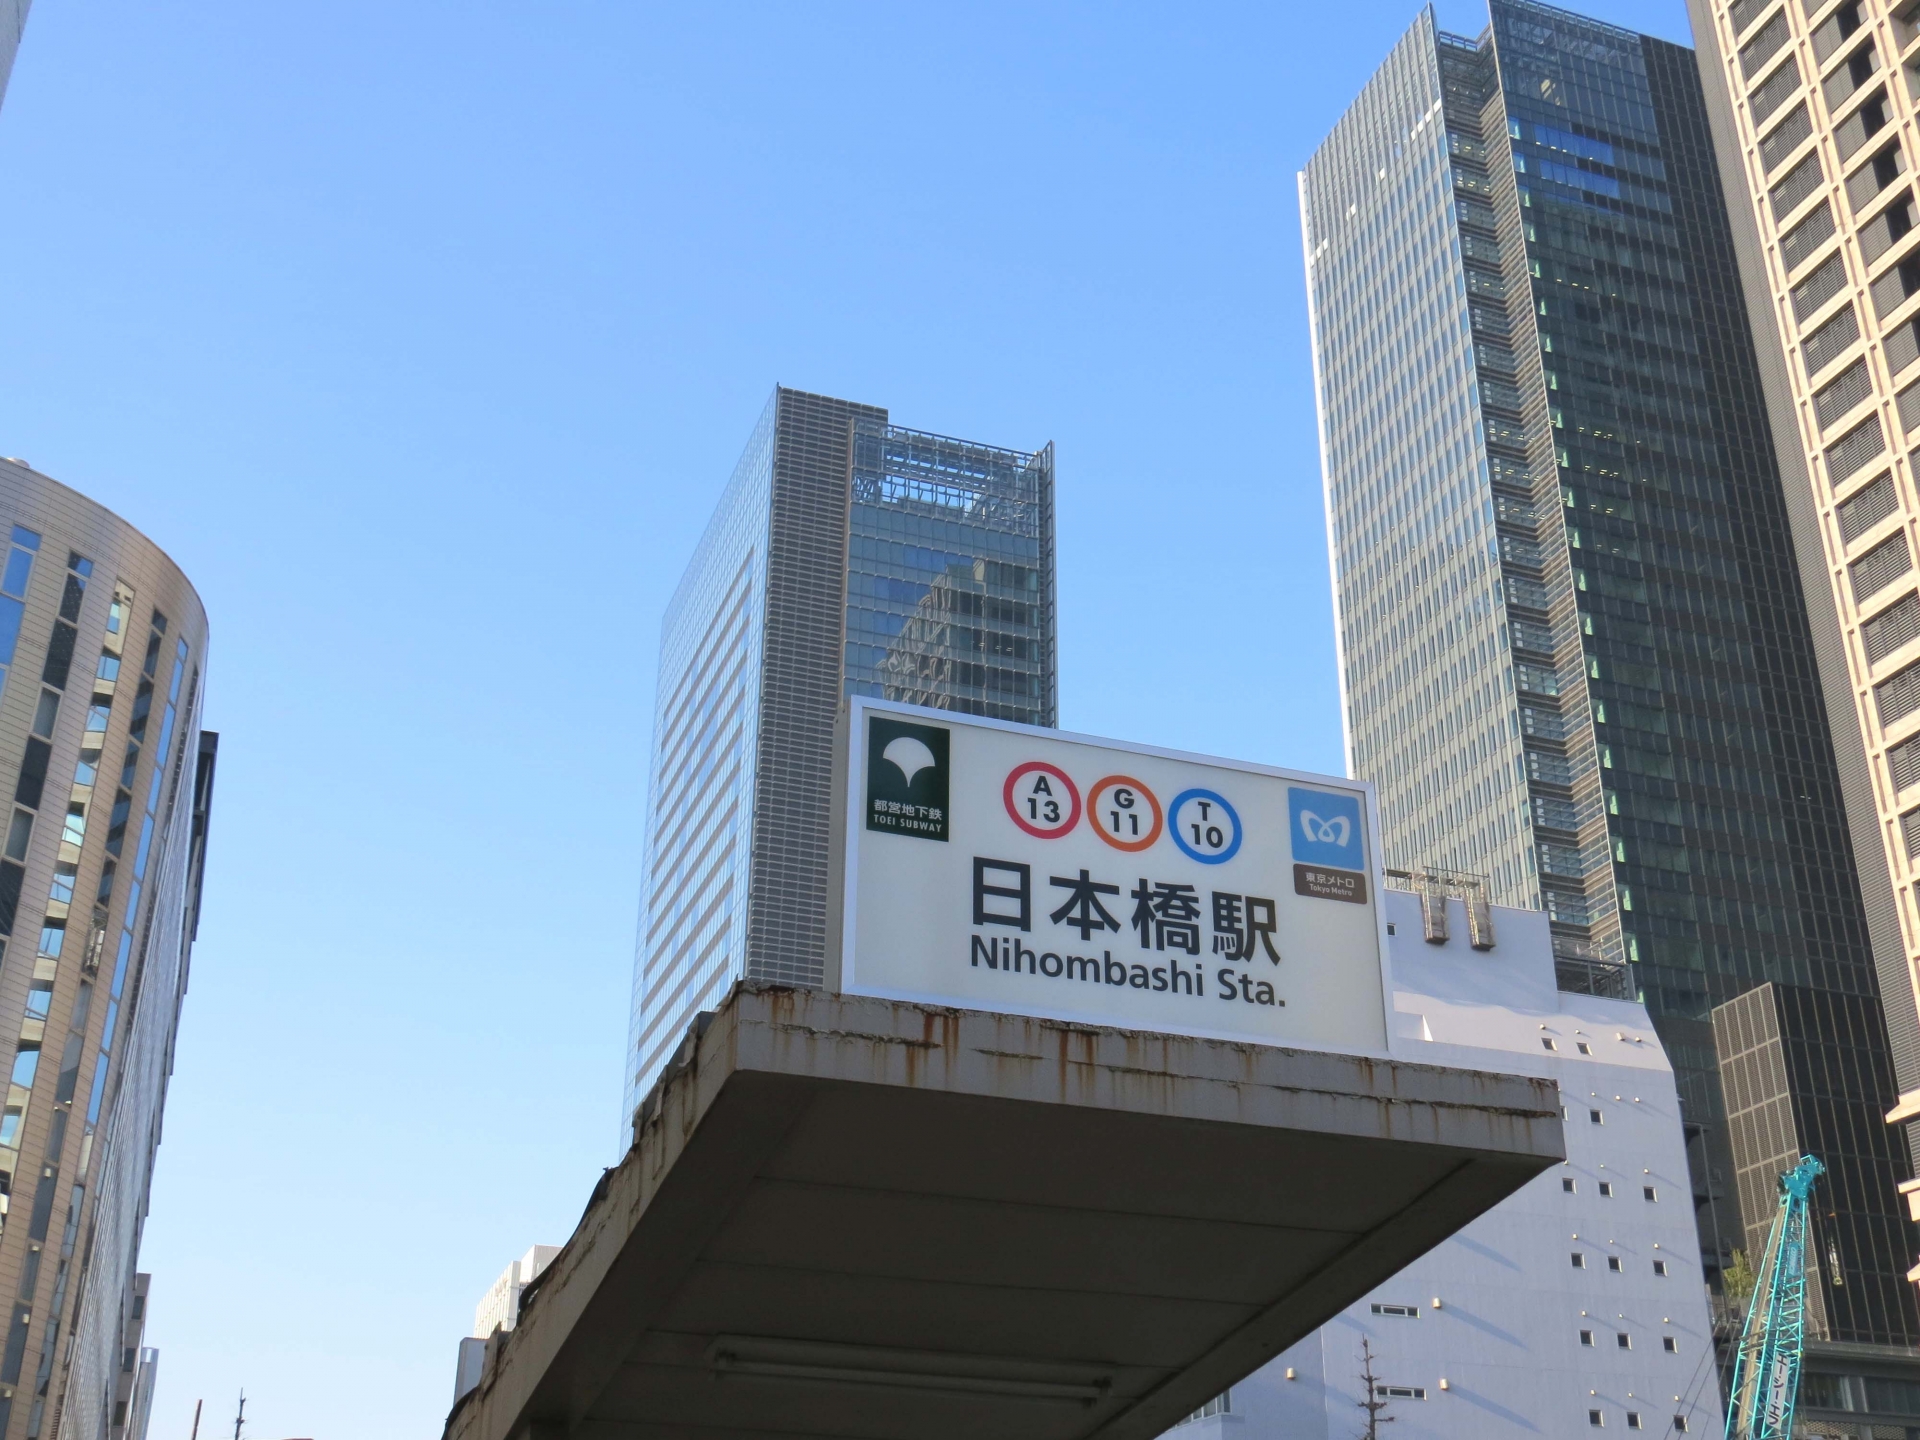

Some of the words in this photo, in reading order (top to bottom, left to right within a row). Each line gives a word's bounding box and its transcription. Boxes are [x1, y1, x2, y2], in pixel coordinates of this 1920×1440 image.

[1033, 775, 1053, 797] A
[1114, 788, 1135, 809] G
[874, 799, 942, 820] 都営地下鉄
[1027, 797, 1060, 823] 13
[1198, 801, 1211, 821] T
[874, 814, 895, 825] TOEI
[900, 818, 942, 832] SUBWAY
[1110, 810, 1139, 835] 11
[1191, 823, 1223, 848] 10
[1305, 872, 1355, 888] 東京メトロ
[1309, 884, 1330, 894] Tokyo
[1331, 886, 1353, 896] Metro
[973, 856, 1281, 966] 日本橋駅
[971, 934, 1204, 997] Nihombashi
[1217, 968, 1286, 1007] Sta.
